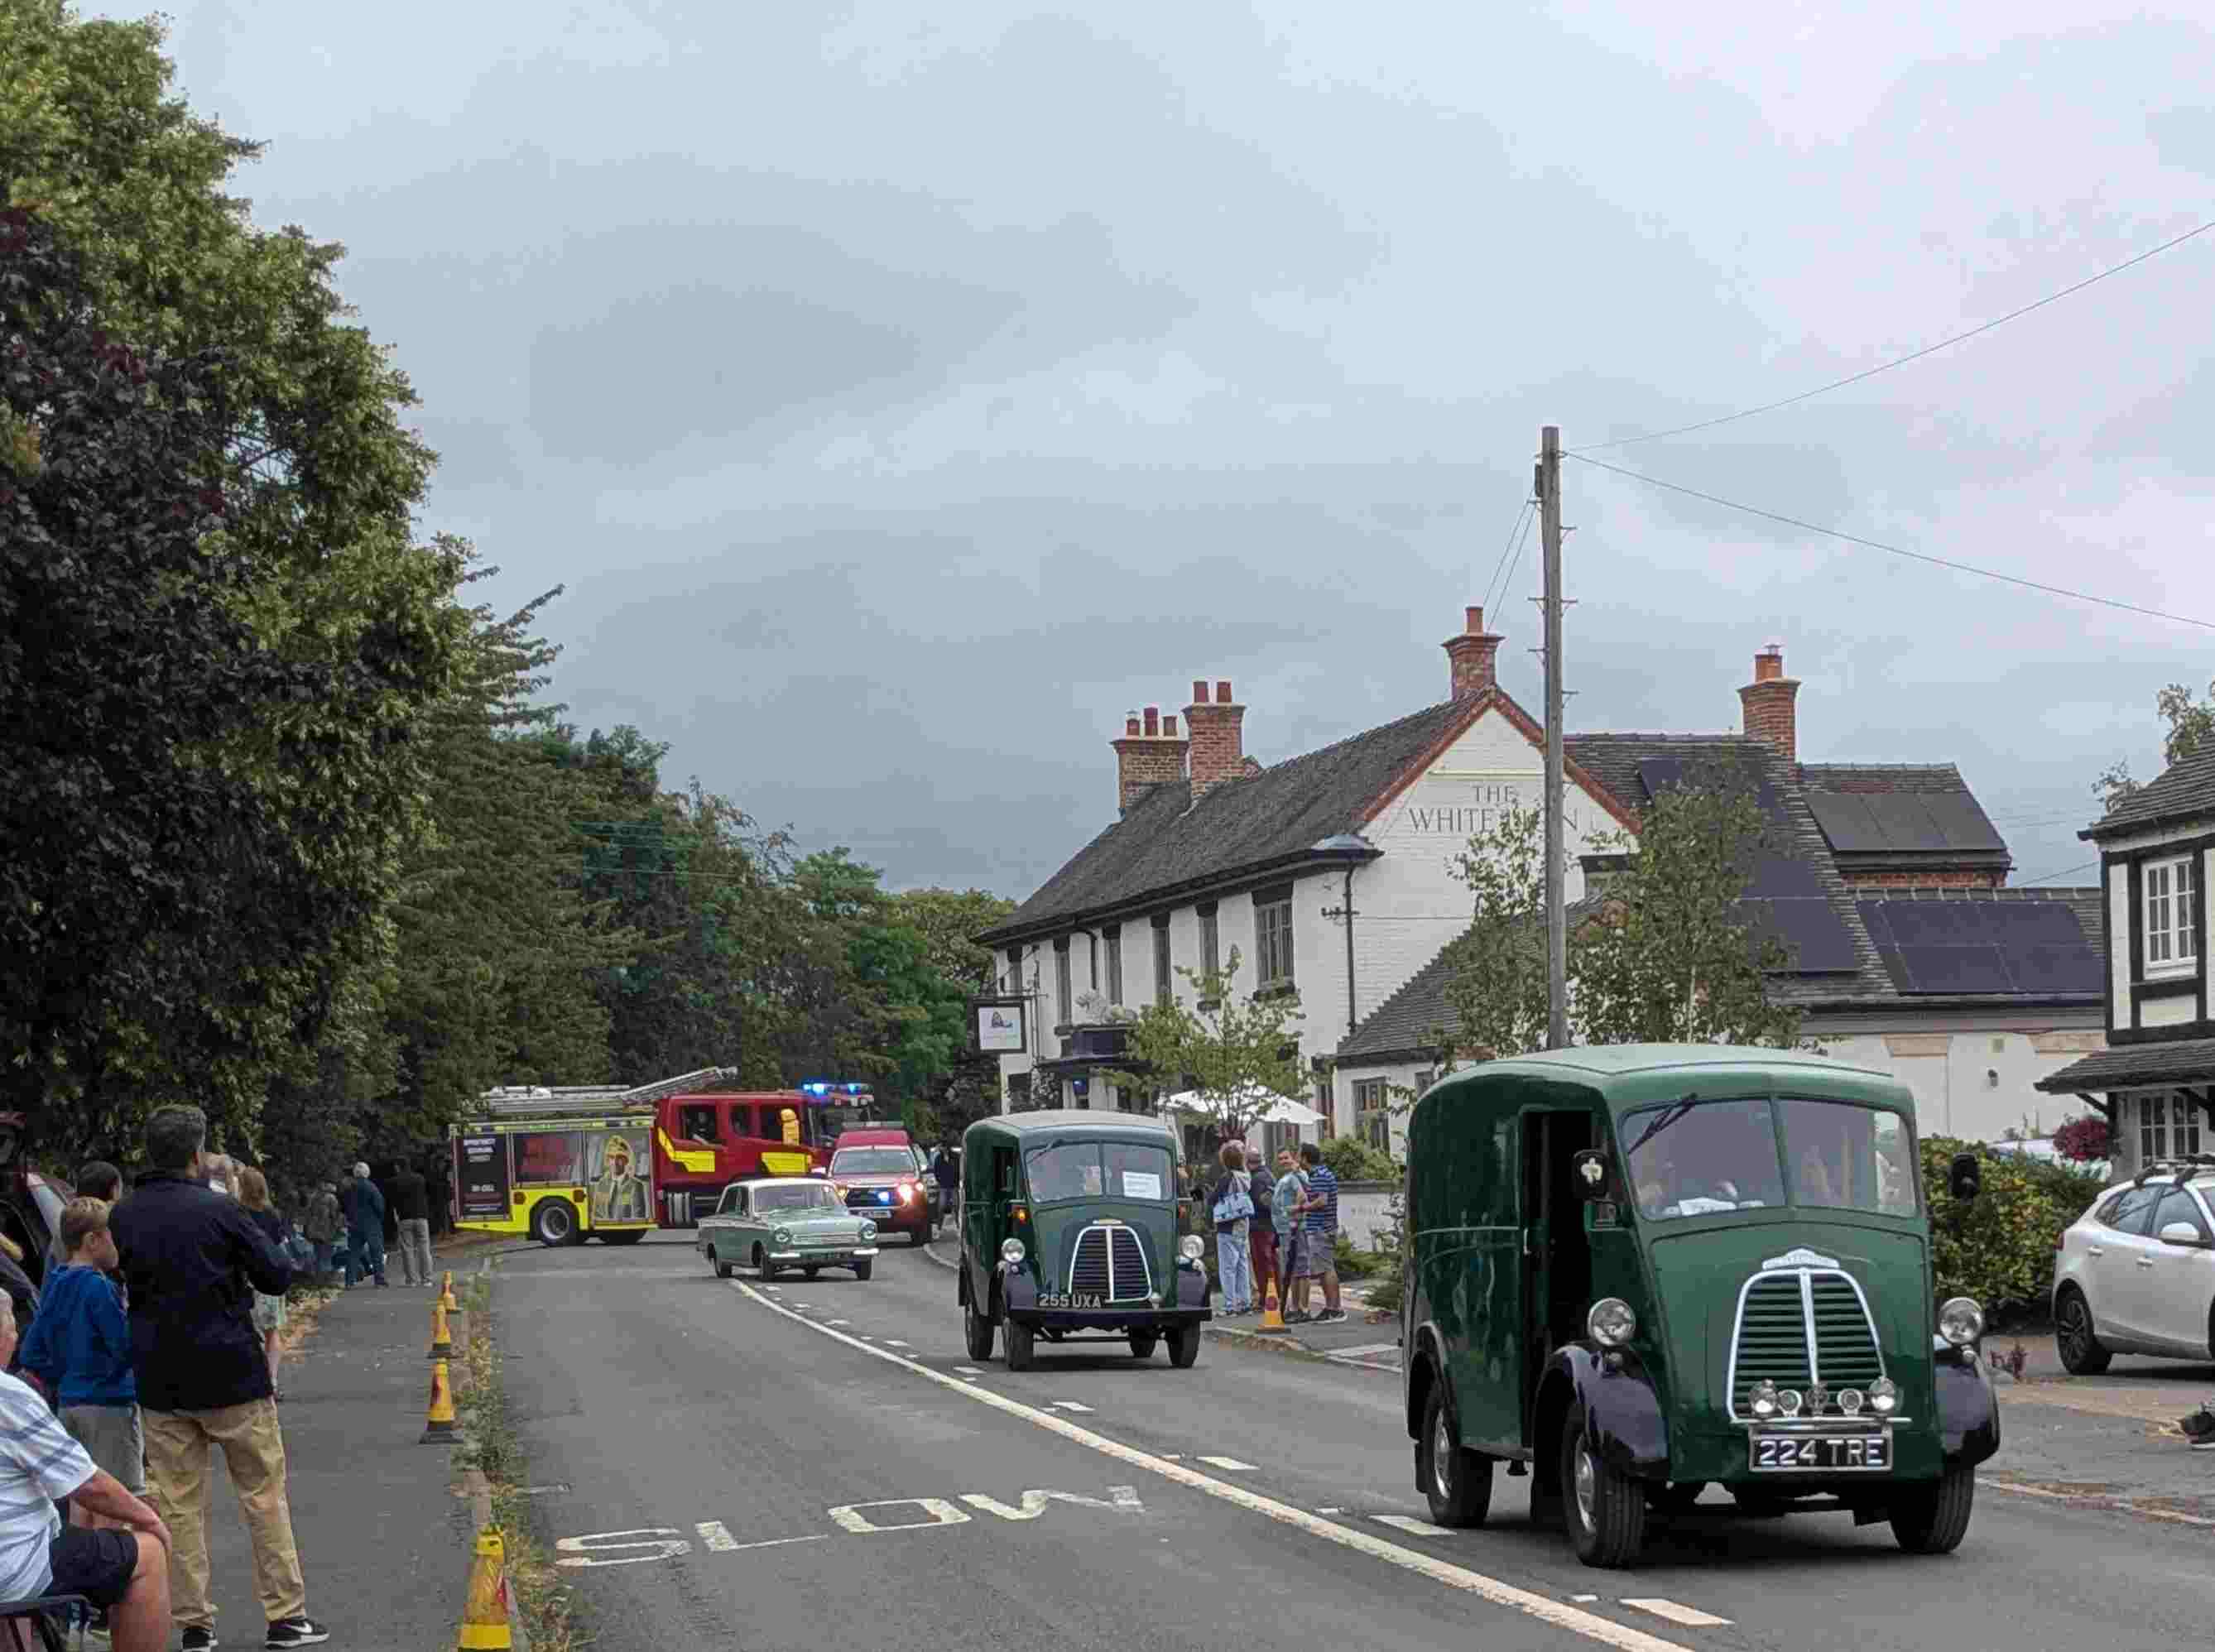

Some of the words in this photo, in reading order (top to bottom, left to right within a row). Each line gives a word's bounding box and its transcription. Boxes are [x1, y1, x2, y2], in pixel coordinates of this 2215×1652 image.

[1471, 785, 1518, 802] THE
[1409, 807, 1495, 833] WHITE
[1072, 1294, 1102, 1309] UXA
[1759, 1439, 1818, 1465] 224
[1826, 1438, 1884, 1465] TRE
[555, 1484, 1146, 1567] SLOW
